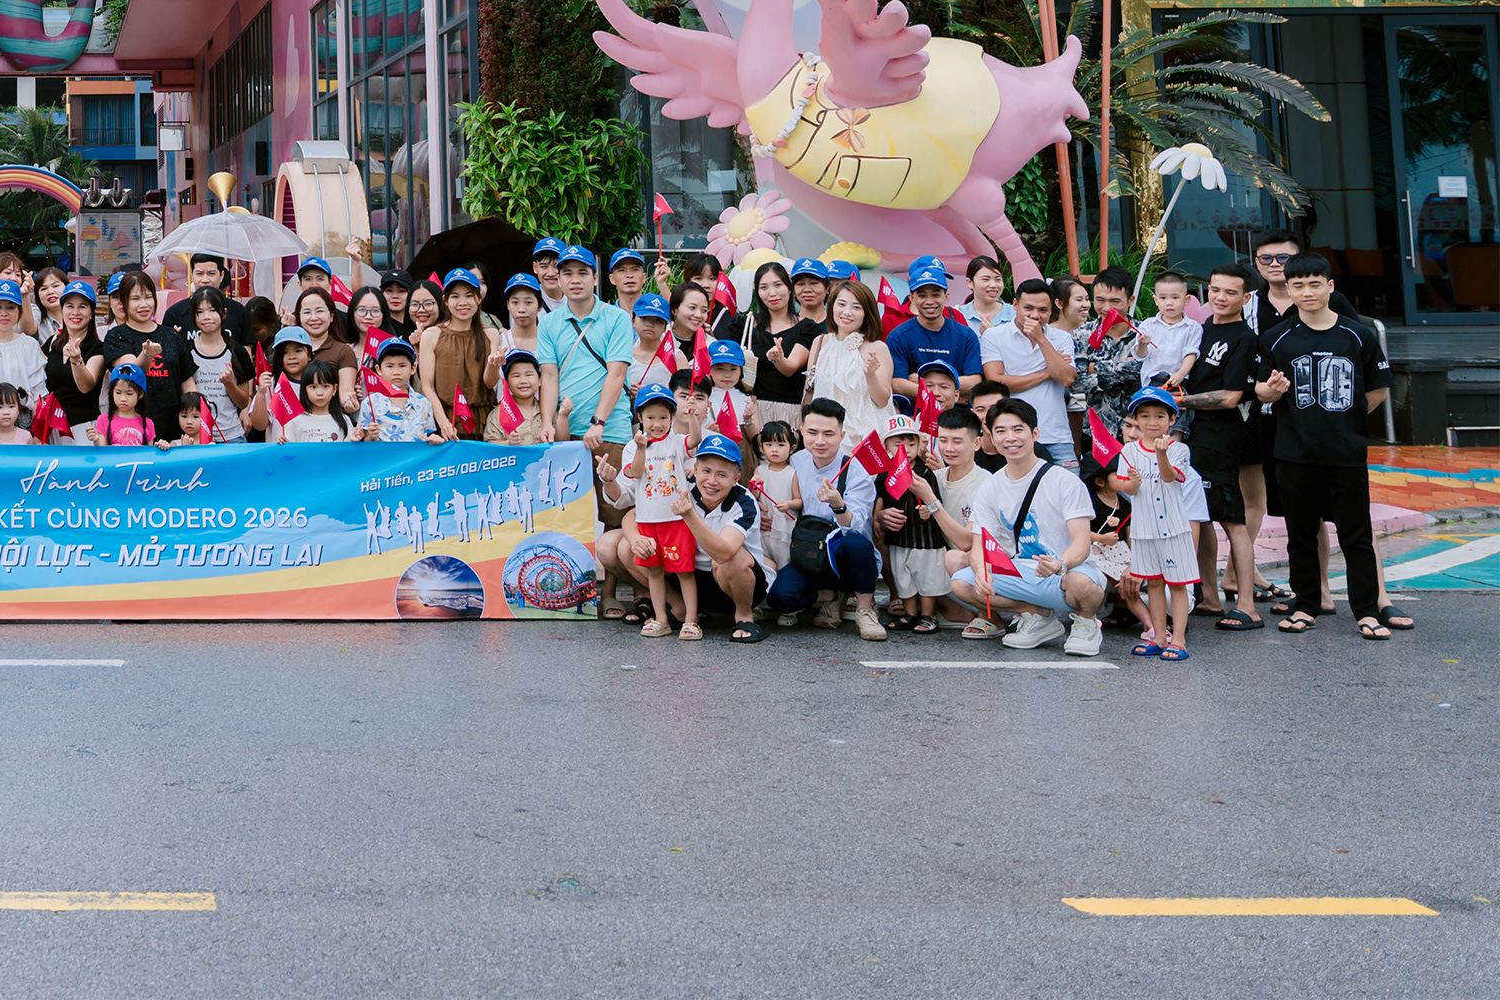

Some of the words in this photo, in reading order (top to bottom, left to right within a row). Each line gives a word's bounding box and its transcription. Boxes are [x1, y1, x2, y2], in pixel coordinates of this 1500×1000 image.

[1291, 355, 1355, 412] 10
[279, 392, 293, 415] MODERO
[888, 416, 913, 430] BOY
[867, 444, 883, 468] MODERO
[20, 458, 110, 496] Hành
[115, 461, 210, 496] Trình
[360, 477, 381, 493] Hải
[384, 472, 414, 491] Tiến,
[417, 455, 517, 483] 23-25/08/2026
[47, 501, 121, 529] CÙNG
[128, 508, 237, 529] MODERO
[244, 507, 308, 529] 2026
[36, 541, 94, 573] LỰC
[118, 536, 169, 567] MỞ
[174, 542, 273, 567] TƯƠNG
[280, 543, 324, 567] LAI
